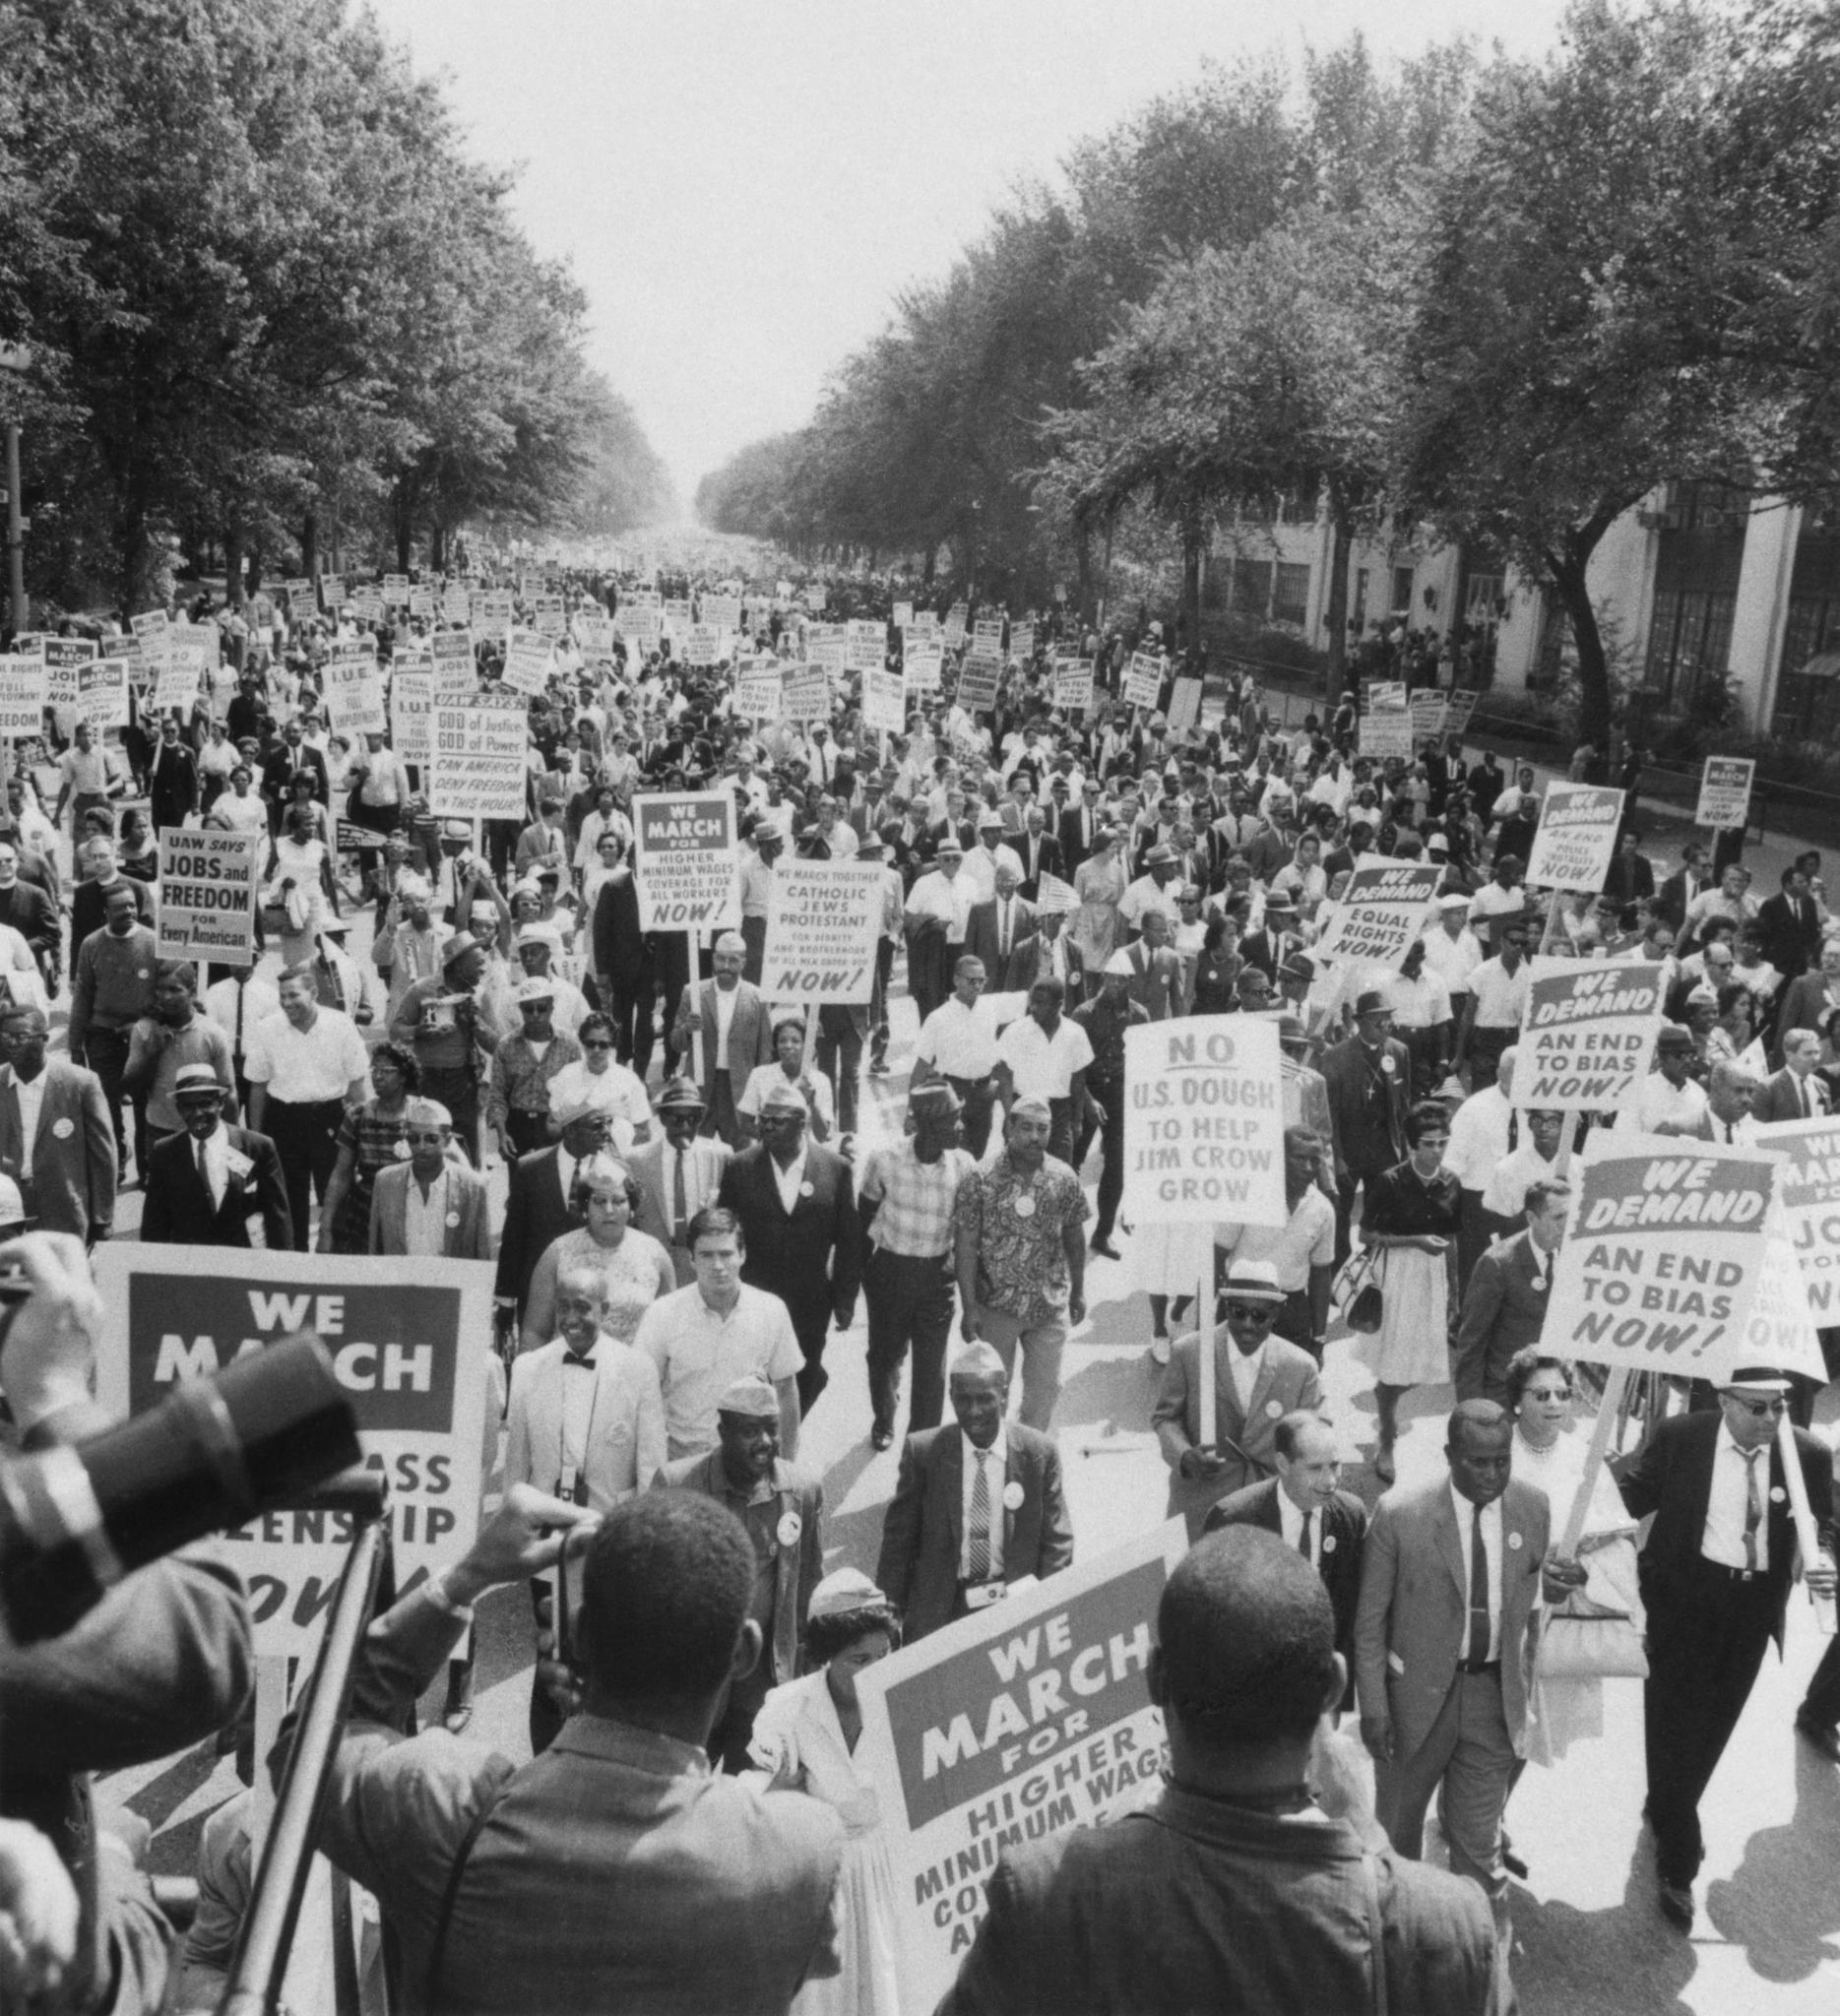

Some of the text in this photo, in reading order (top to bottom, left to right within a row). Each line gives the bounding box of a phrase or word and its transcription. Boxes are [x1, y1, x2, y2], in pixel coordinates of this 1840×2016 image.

[48, 651, 92, 662] MARCH
[12, 663, 42, 673] RIGHTS
[81, 672, 120, 685] MARCH
[0, 714, 38, 726] EEDOM
[438, 712, 466, 729] GOD
[470, 715, 481, 730] of
[438, 731, 465, 749] GOD
[470, 735, 482, 750] of
[436, 759, 522, 774] CAN AMERICA
[434, 778, 523, 793] DENY FREEDOM
[1710, 772, 1746, 782] MARCH
[452, 796, 478, 809] THIS
[480, 798, 525, 811] HOUR?
[1568, 792, 1599, 808] WE
[670, 804, 696, 819] WE
[1545, 805, 1617, 826] DEMAND
[1702, 811, 1742, 821] NOW!
[648, 818, 722, 839] MARCH
[1549, 829, 1604, 844] AN END
[169, 836, 246, 853] UAW SAYS
[670, 839, 700, 849] FOR
[163, 854, 248, 881] JOBS and
[660, 852, 715, 864] HIGHER
[642, 864, 733, 878] MINIMUM WAGES
[777, 869, 881, 883] WE MARCH TOGETHER
[1379, 869, 1418, 885] WE
[1539, 862, 1602, 882] NOW!
[647, 876, 731, 890] COVERAGE FOR
[788, 886, 866, 900] CATHOLIC
[1350, 882, 1432, 902] DEMAND
[162, 884, 248, 912] FREEDOM
[651, 888, 728, 901] ALL WORKERS
[653, 900, 728, 923] NOW!
[800, 901, 849, 913] JEWS
[192, 914, 217, 924] FOR
[780, 914, 867, 926] PROTESTANT
[1351, 908, 1409, 928] EQUAL
[160, 922, 246, 948] Every American
[1342, 923, 1407, 944] RIGHTS
[1332, 939, 1402, 960] NOW!
[777, 967, 864, 992] NOW!
[1572, 970, 1622, 996] WE
[1536, 987, 1654, 1024] DEMAND
[1169, 1034, 1235, 1063] NO
[1536, 1034, 1643, 1051] AN END
[1536, 1054, 1636, 1073] TO BIAS
[1133, 1078, 1275, 1109] U.S. DOUGH
[1531, 1075, 1633, 1098] NOW!
[1148, 1116, 1260, 1142] TO HELP
[1134, 1146, 1273, 1172] JIM CROW
[1642, 1158, 1718, 1191] WE
[1159, 1178, 1250, 1202] GROW
[1584, 1189, 1764, 1229] DEMAND
[1583, 1244, 1643, 1275] AN
[1655, 1252, 1744, 1288] END
[1799, 1254, 1840, 1271] FO
[1583, 1277, 1733, 1320] TO BIAS
[1808, 1281, 1840, 1311] N
[248, 1291, 346, 1335] WE
[1572, 1311, 1725, 1357] NOW!
[154, 1333, 432, 1393] MCH
[224, 1505, 455, 1544] ENSIP
[987, 1612, 1073, 1683] WE
[923, 1622, 1151, 1781] MARCH
[1000, 1709, 1089, 1773] FOR
[968, 1727, 1138, 1838] HIGHER
[915, 1794, 1076, 1907] MINIMUM
[934, 1879, 988, 1928] CO
